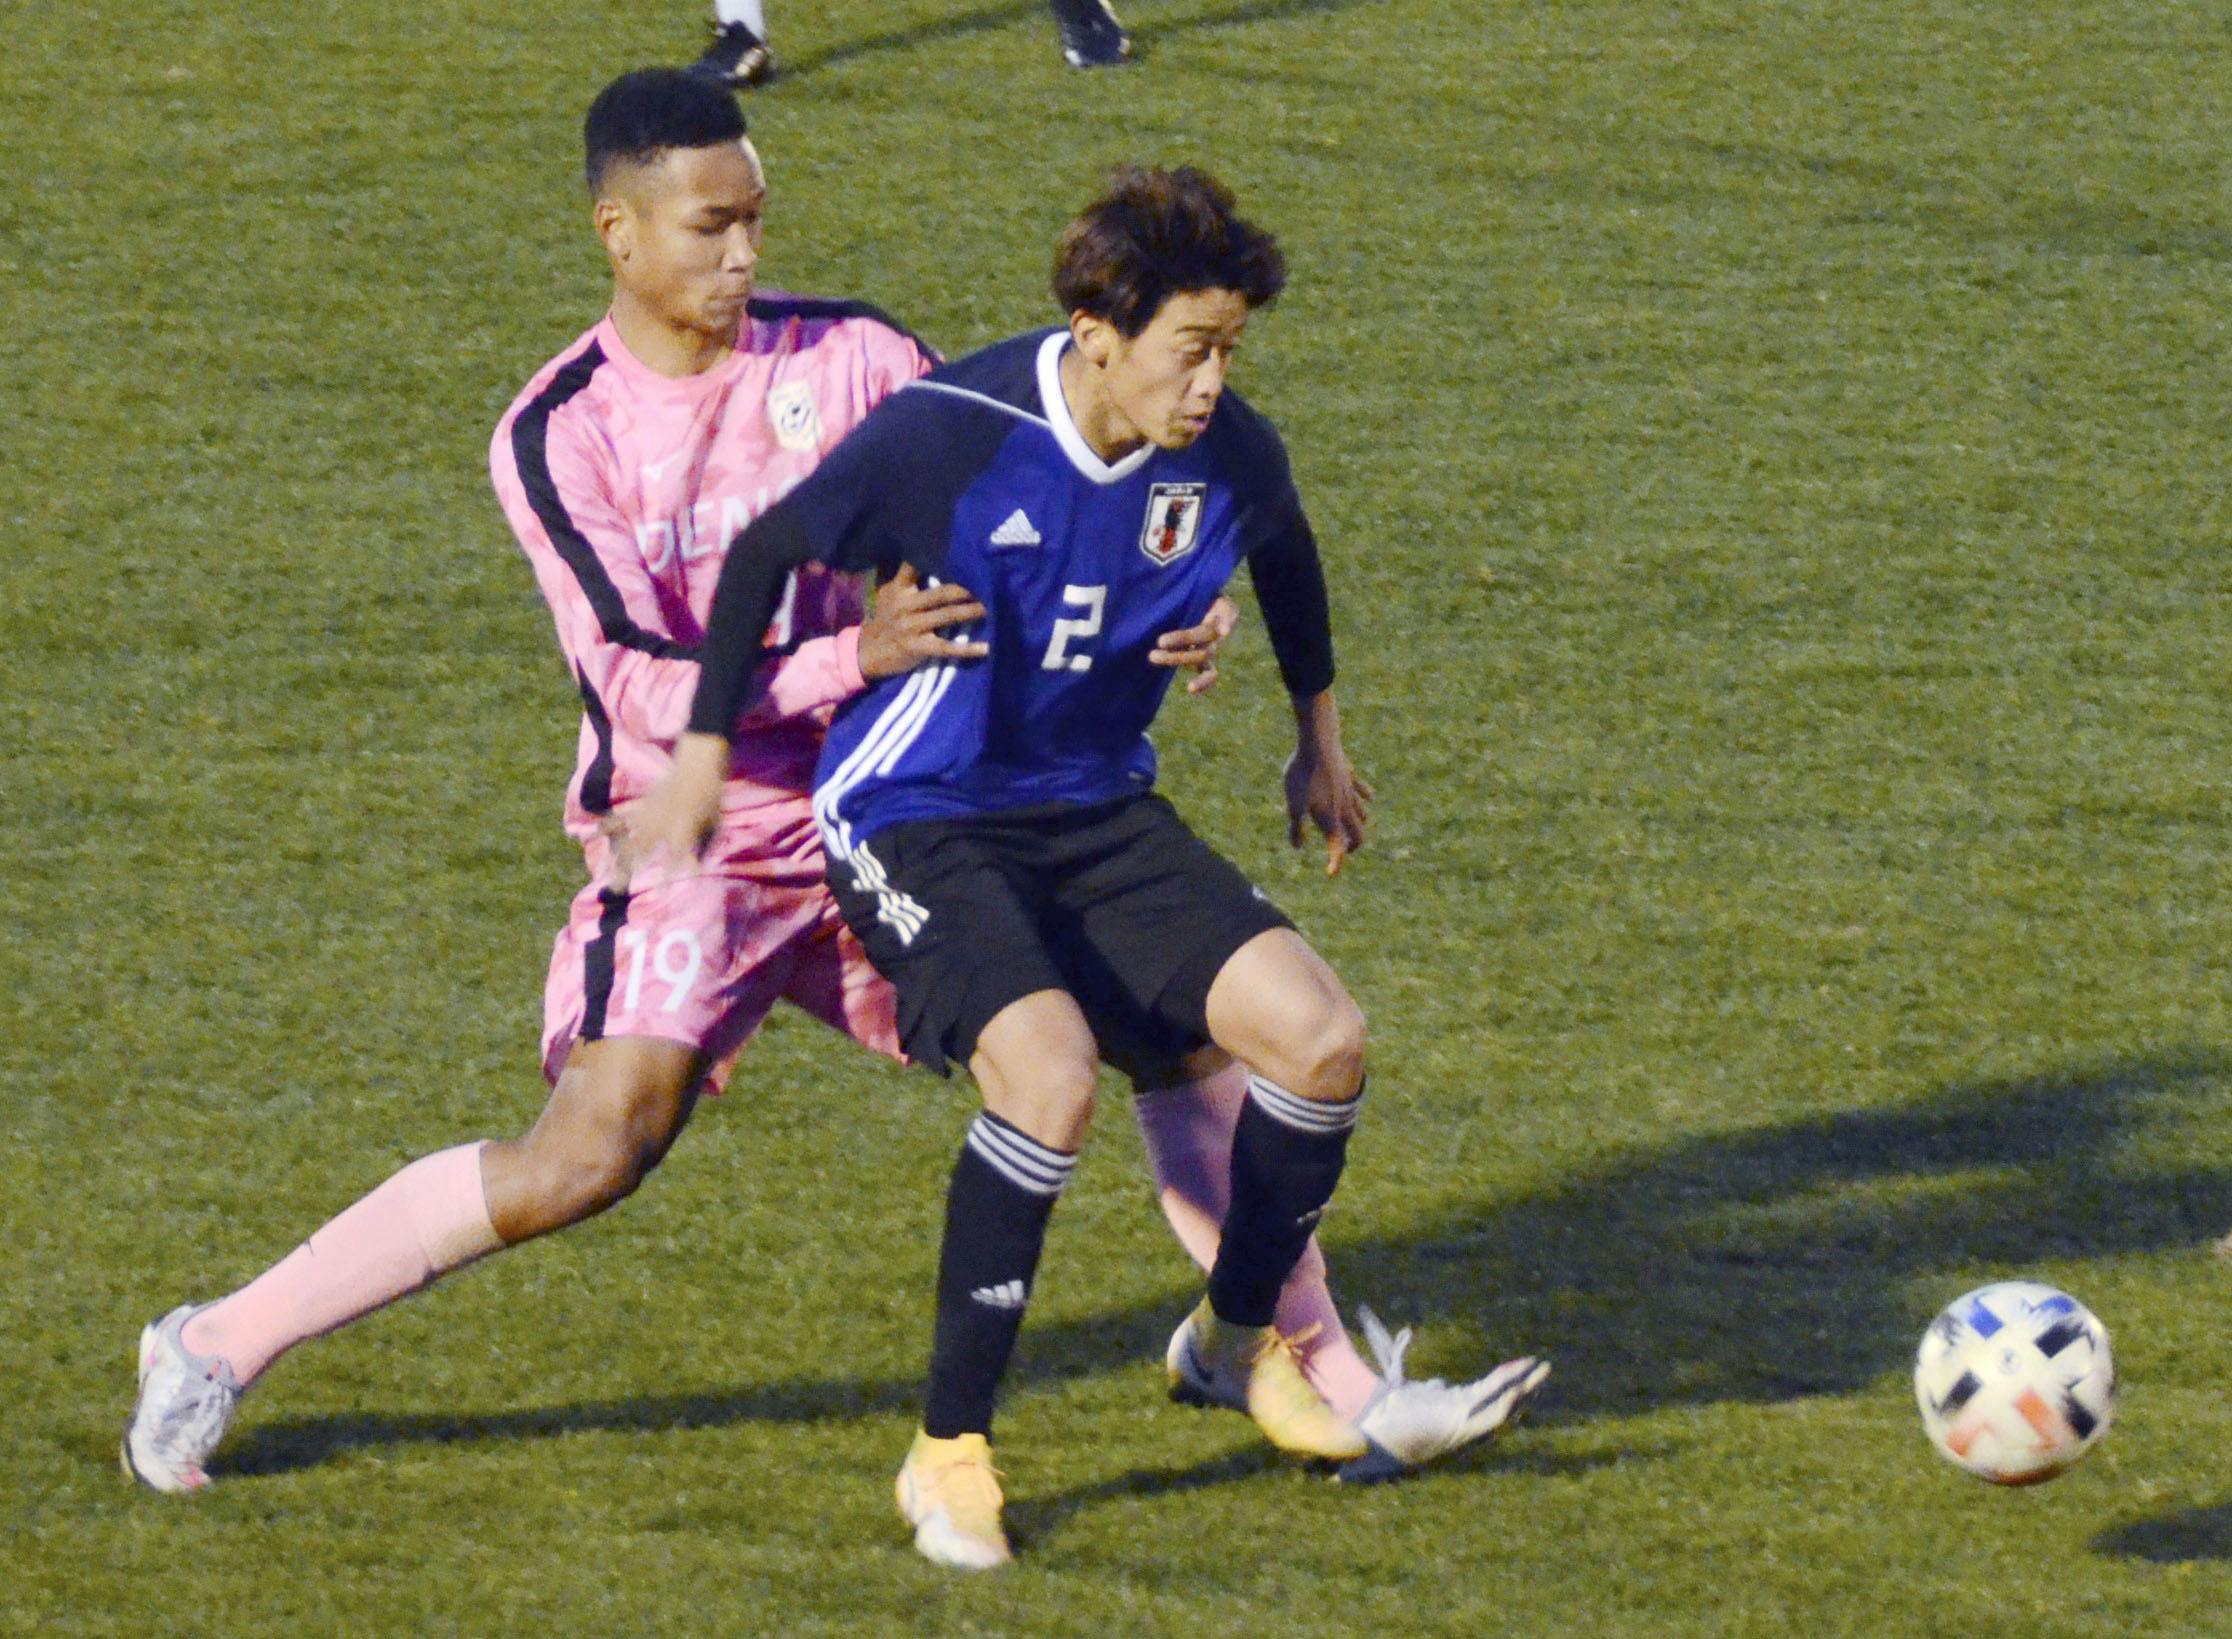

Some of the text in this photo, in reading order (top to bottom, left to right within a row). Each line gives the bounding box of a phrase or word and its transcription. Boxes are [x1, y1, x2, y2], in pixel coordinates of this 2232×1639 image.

[636, 473, 803, 574] DEN
[1041, 584, 1106, 671] 2
[620, 929, 703, 1013] 19
